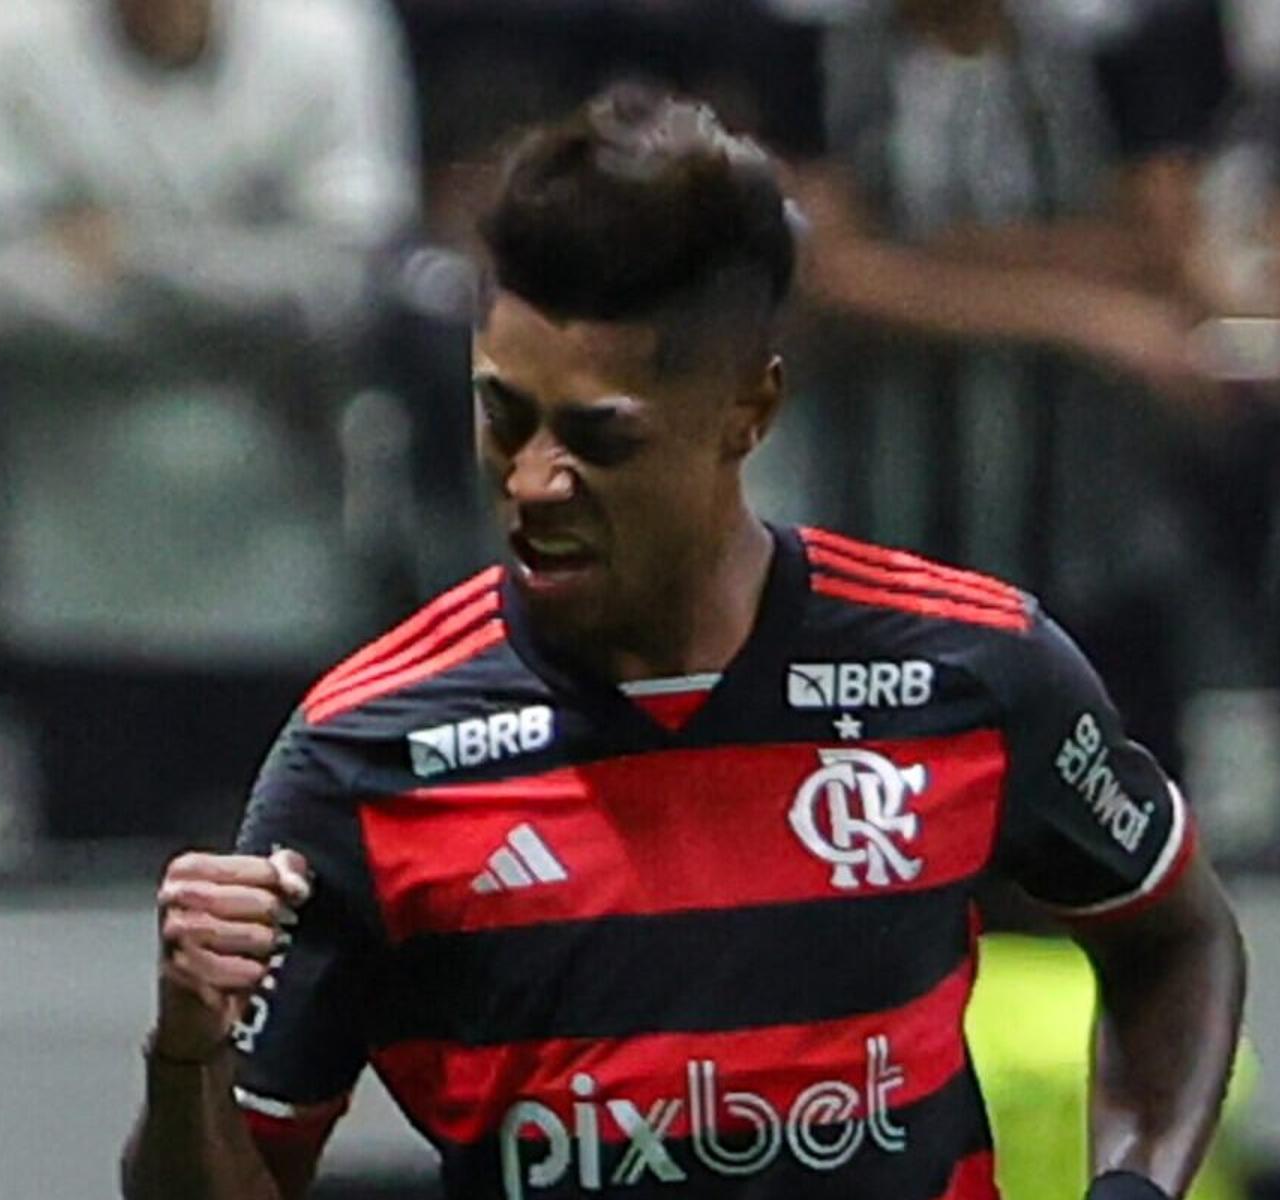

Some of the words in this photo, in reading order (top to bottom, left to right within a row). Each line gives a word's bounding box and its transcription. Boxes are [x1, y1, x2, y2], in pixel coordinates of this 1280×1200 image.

[837, 660, 933, 706] BRB
[457, 705, 553, 765] BRB
[1076, 746, 1156, 853] kwai
